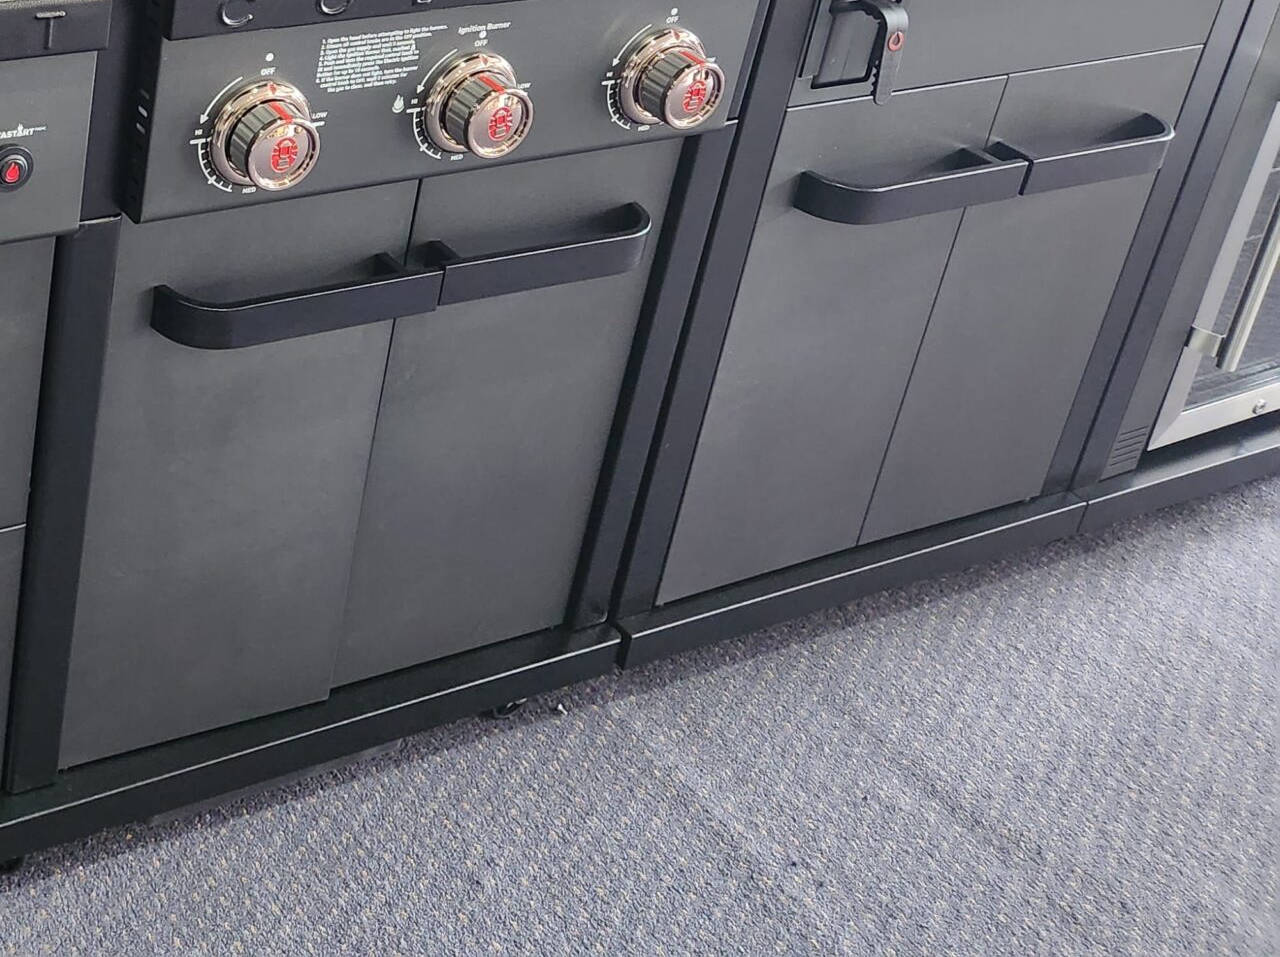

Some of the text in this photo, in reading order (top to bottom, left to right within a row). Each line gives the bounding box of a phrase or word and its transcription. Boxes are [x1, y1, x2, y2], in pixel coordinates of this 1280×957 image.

[666, 16, 679, 24] OFF
[458, 22, 512, 35] Ignition Burner
[474, 39, 488, 47] OFF
[261, 67, 276, 76] OFF
[312, 111, 328, 119] LOW
[242, 186, 257, 194] MED
